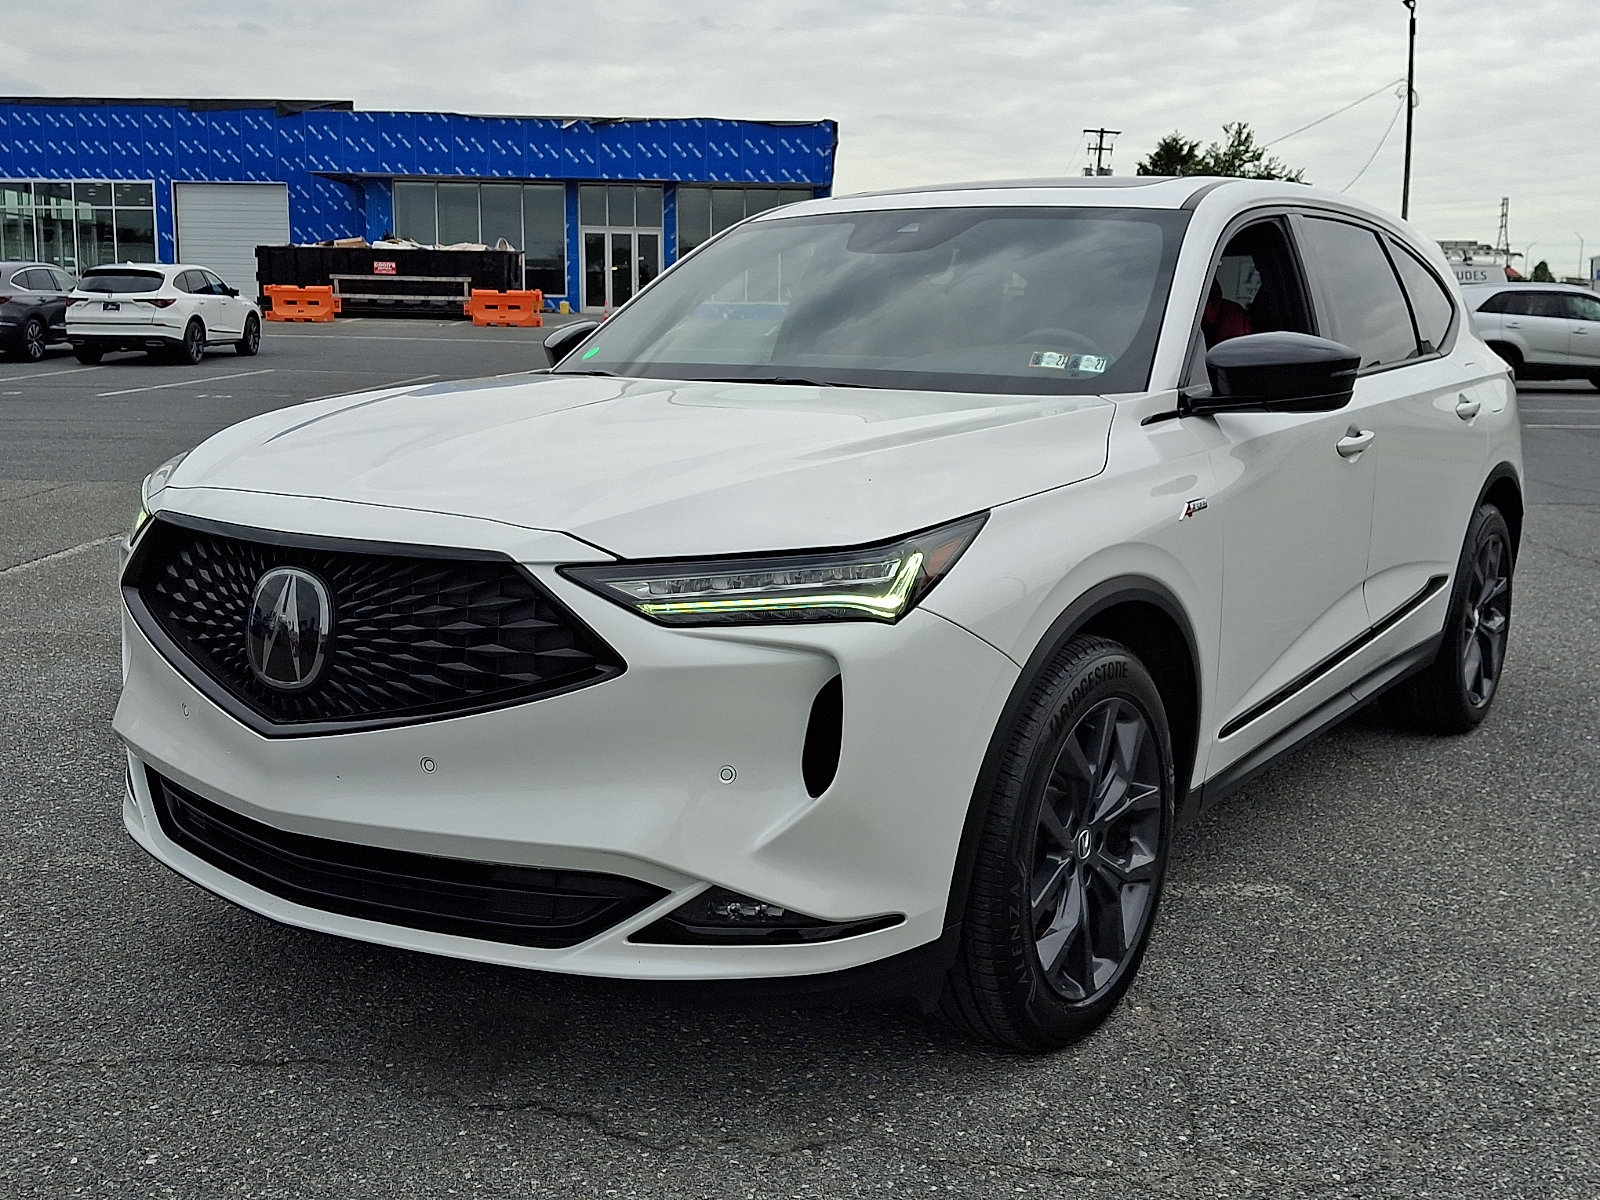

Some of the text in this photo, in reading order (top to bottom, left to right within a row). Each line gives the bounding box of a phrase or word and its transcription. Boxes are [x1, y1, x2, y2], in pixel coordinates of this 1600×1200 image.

[1453, 270, 1487, 281] UDES
[1095, 358, 1105, 371] 27
[1049, 661, 1128, 735] BRIDGESTONE
[1010, 882, 1029, 984] ALENZA
